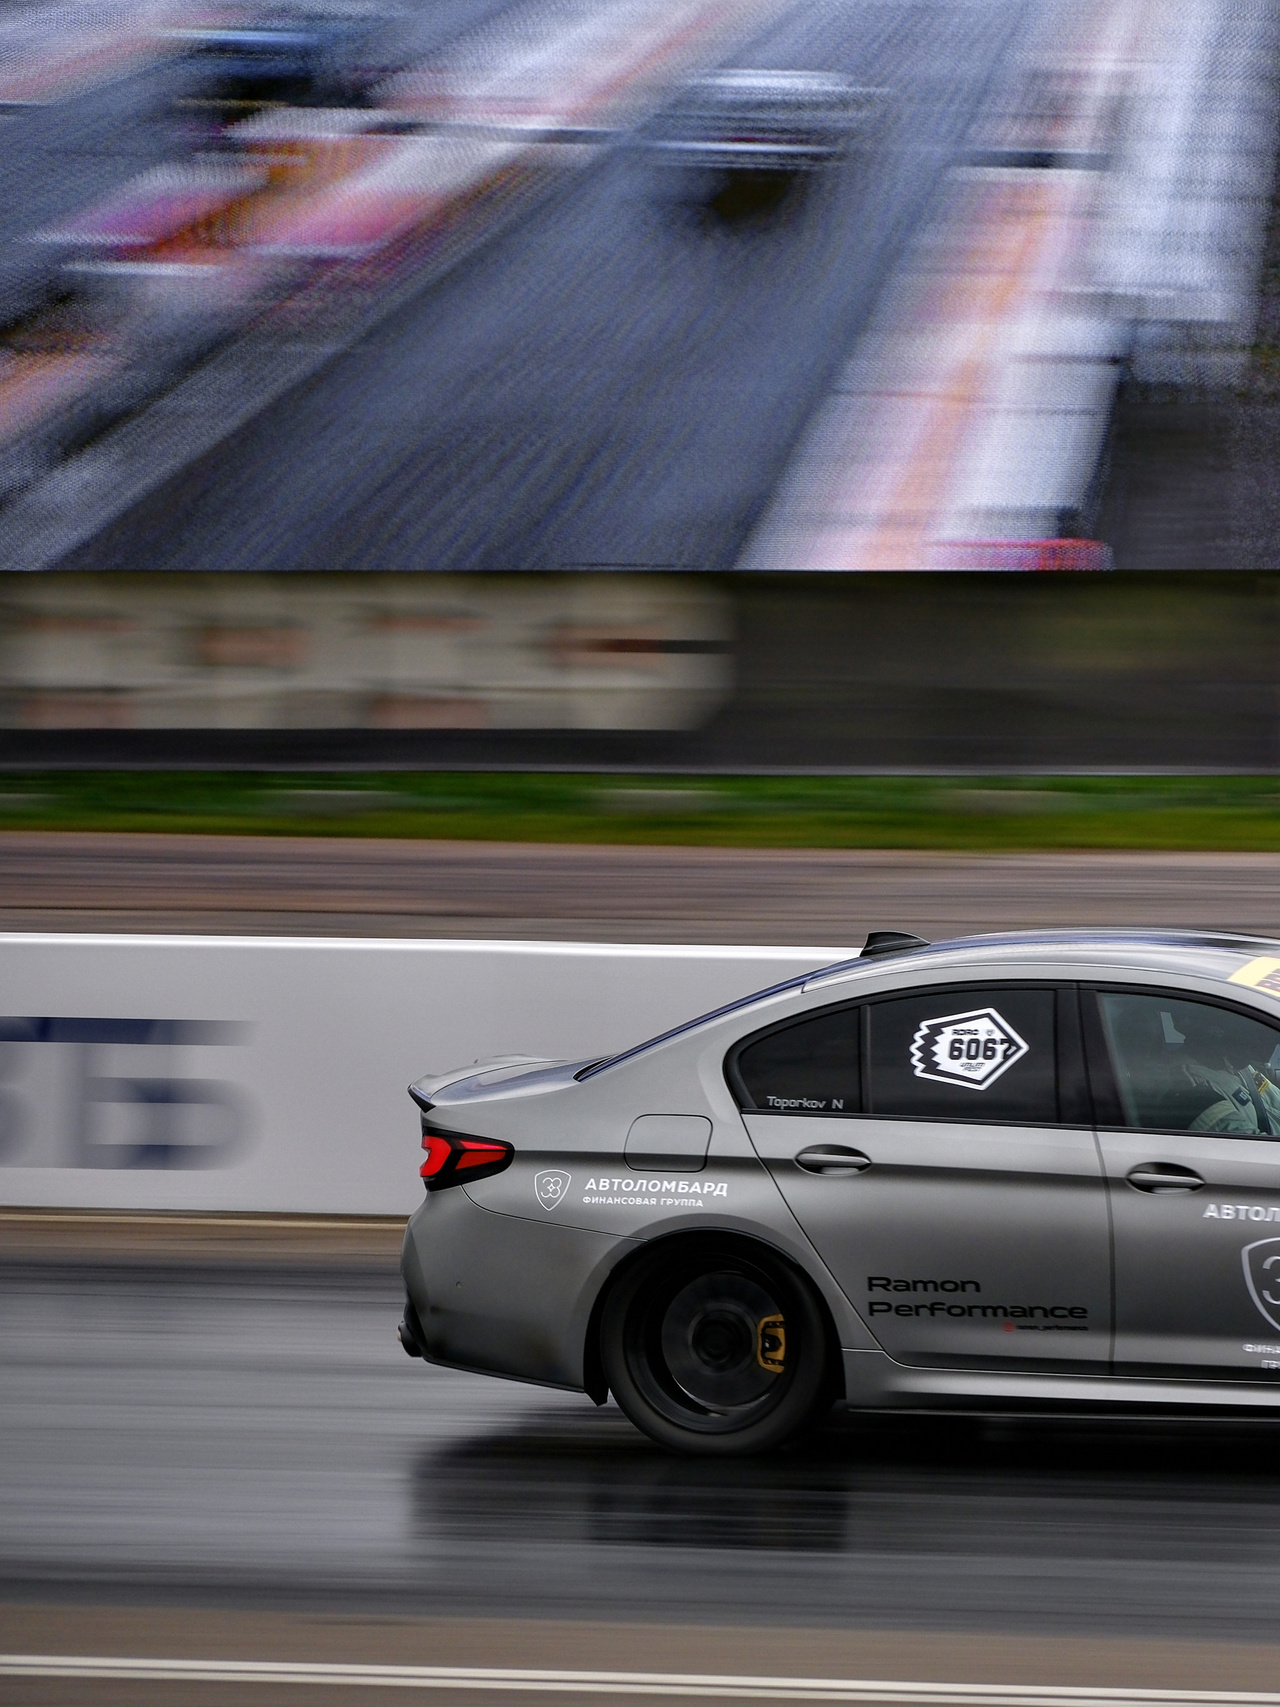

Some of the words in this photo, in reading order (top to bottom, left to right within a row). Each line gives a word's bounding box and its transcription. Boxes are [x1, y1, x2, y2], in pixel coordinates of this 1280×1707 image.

[949, 1038, 1012, 1060] 6067
[766, 1095, 827, 1110] Toporkov
[831, 1098, 844, 1110] N
[584, 1177, 729, 1198] АВТОЛОМБАРД
[582, 1195, 658, 1206] ФИНАНСОВАЯ
[660, 1197, 704, 1208] ГРУППА
[867, 1276, 981, 1293] Ramon
[868, 1301, 1088, 1319] Performance
